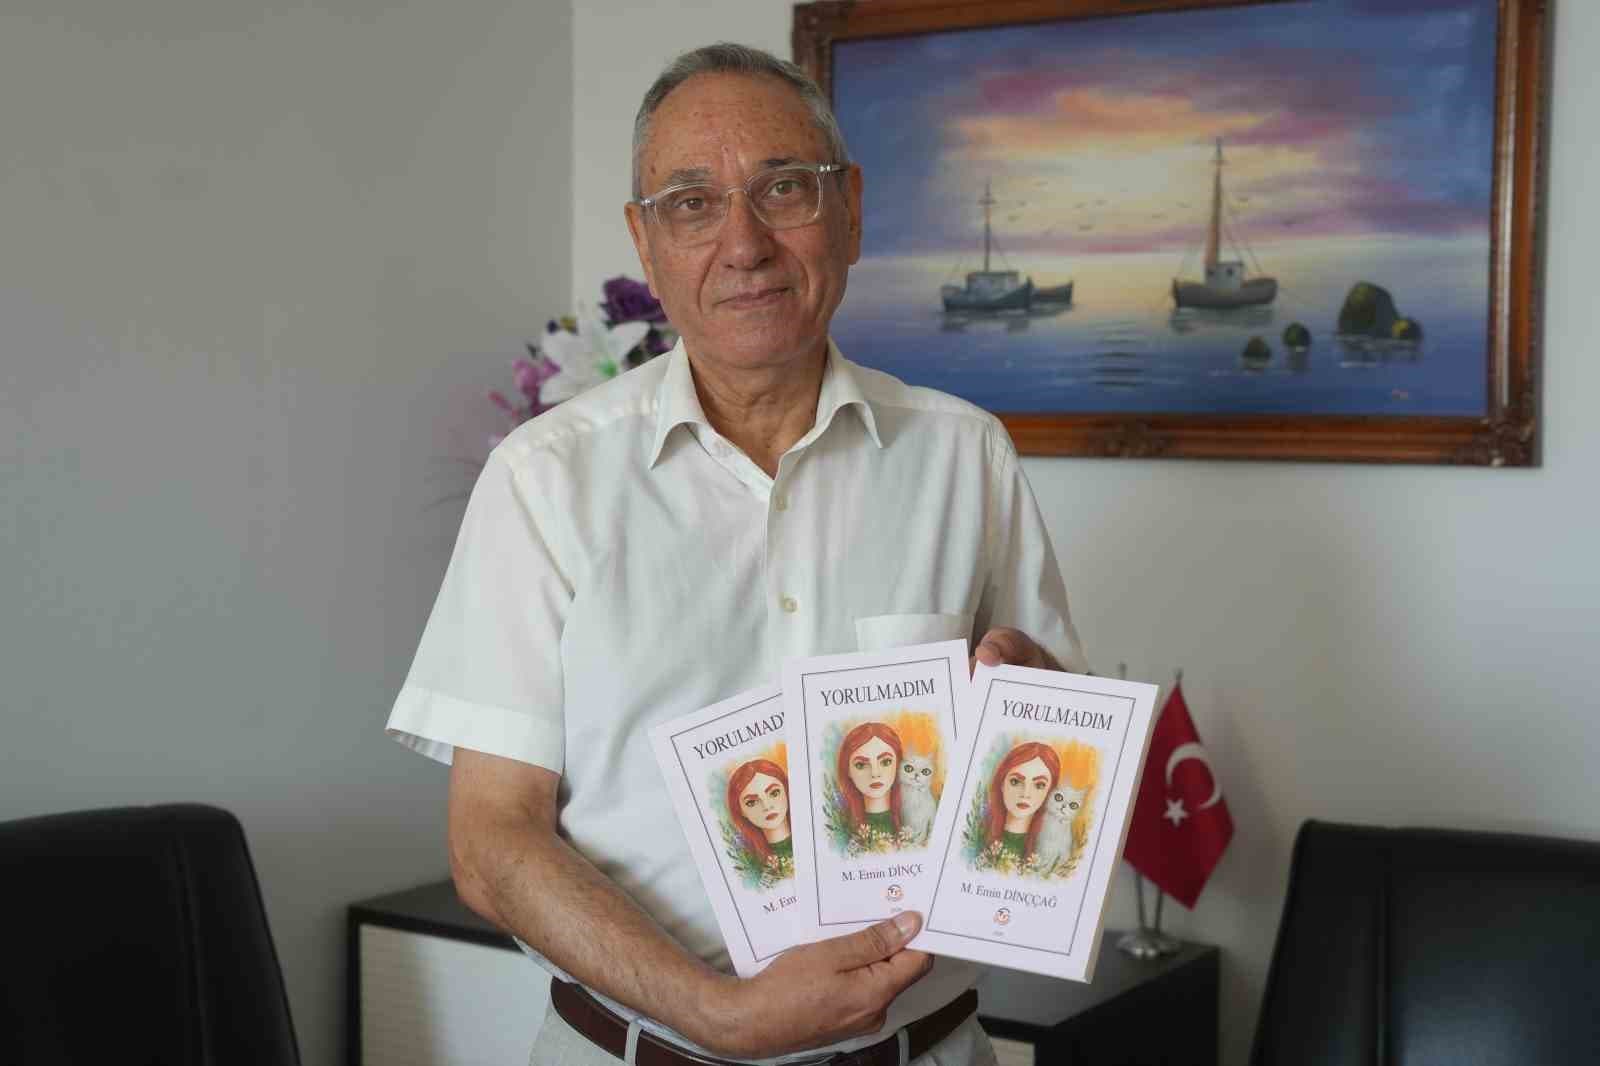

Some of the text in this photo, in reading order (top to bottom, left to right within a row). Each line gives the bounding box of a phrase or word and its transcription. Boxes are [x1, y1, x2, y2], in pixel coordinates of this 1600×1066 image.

[821, 678, 935, 707] YORULMADIM
[1001, 699, 1113, 731] YORULMADIM
[693, 712, 785, 760] YORULMAD
[841, 871, 856, 881] M.
[859, 869, 885, 881] Emin
[960, 882, 1057, 908] M. Emin DİNÇÇAĞ
